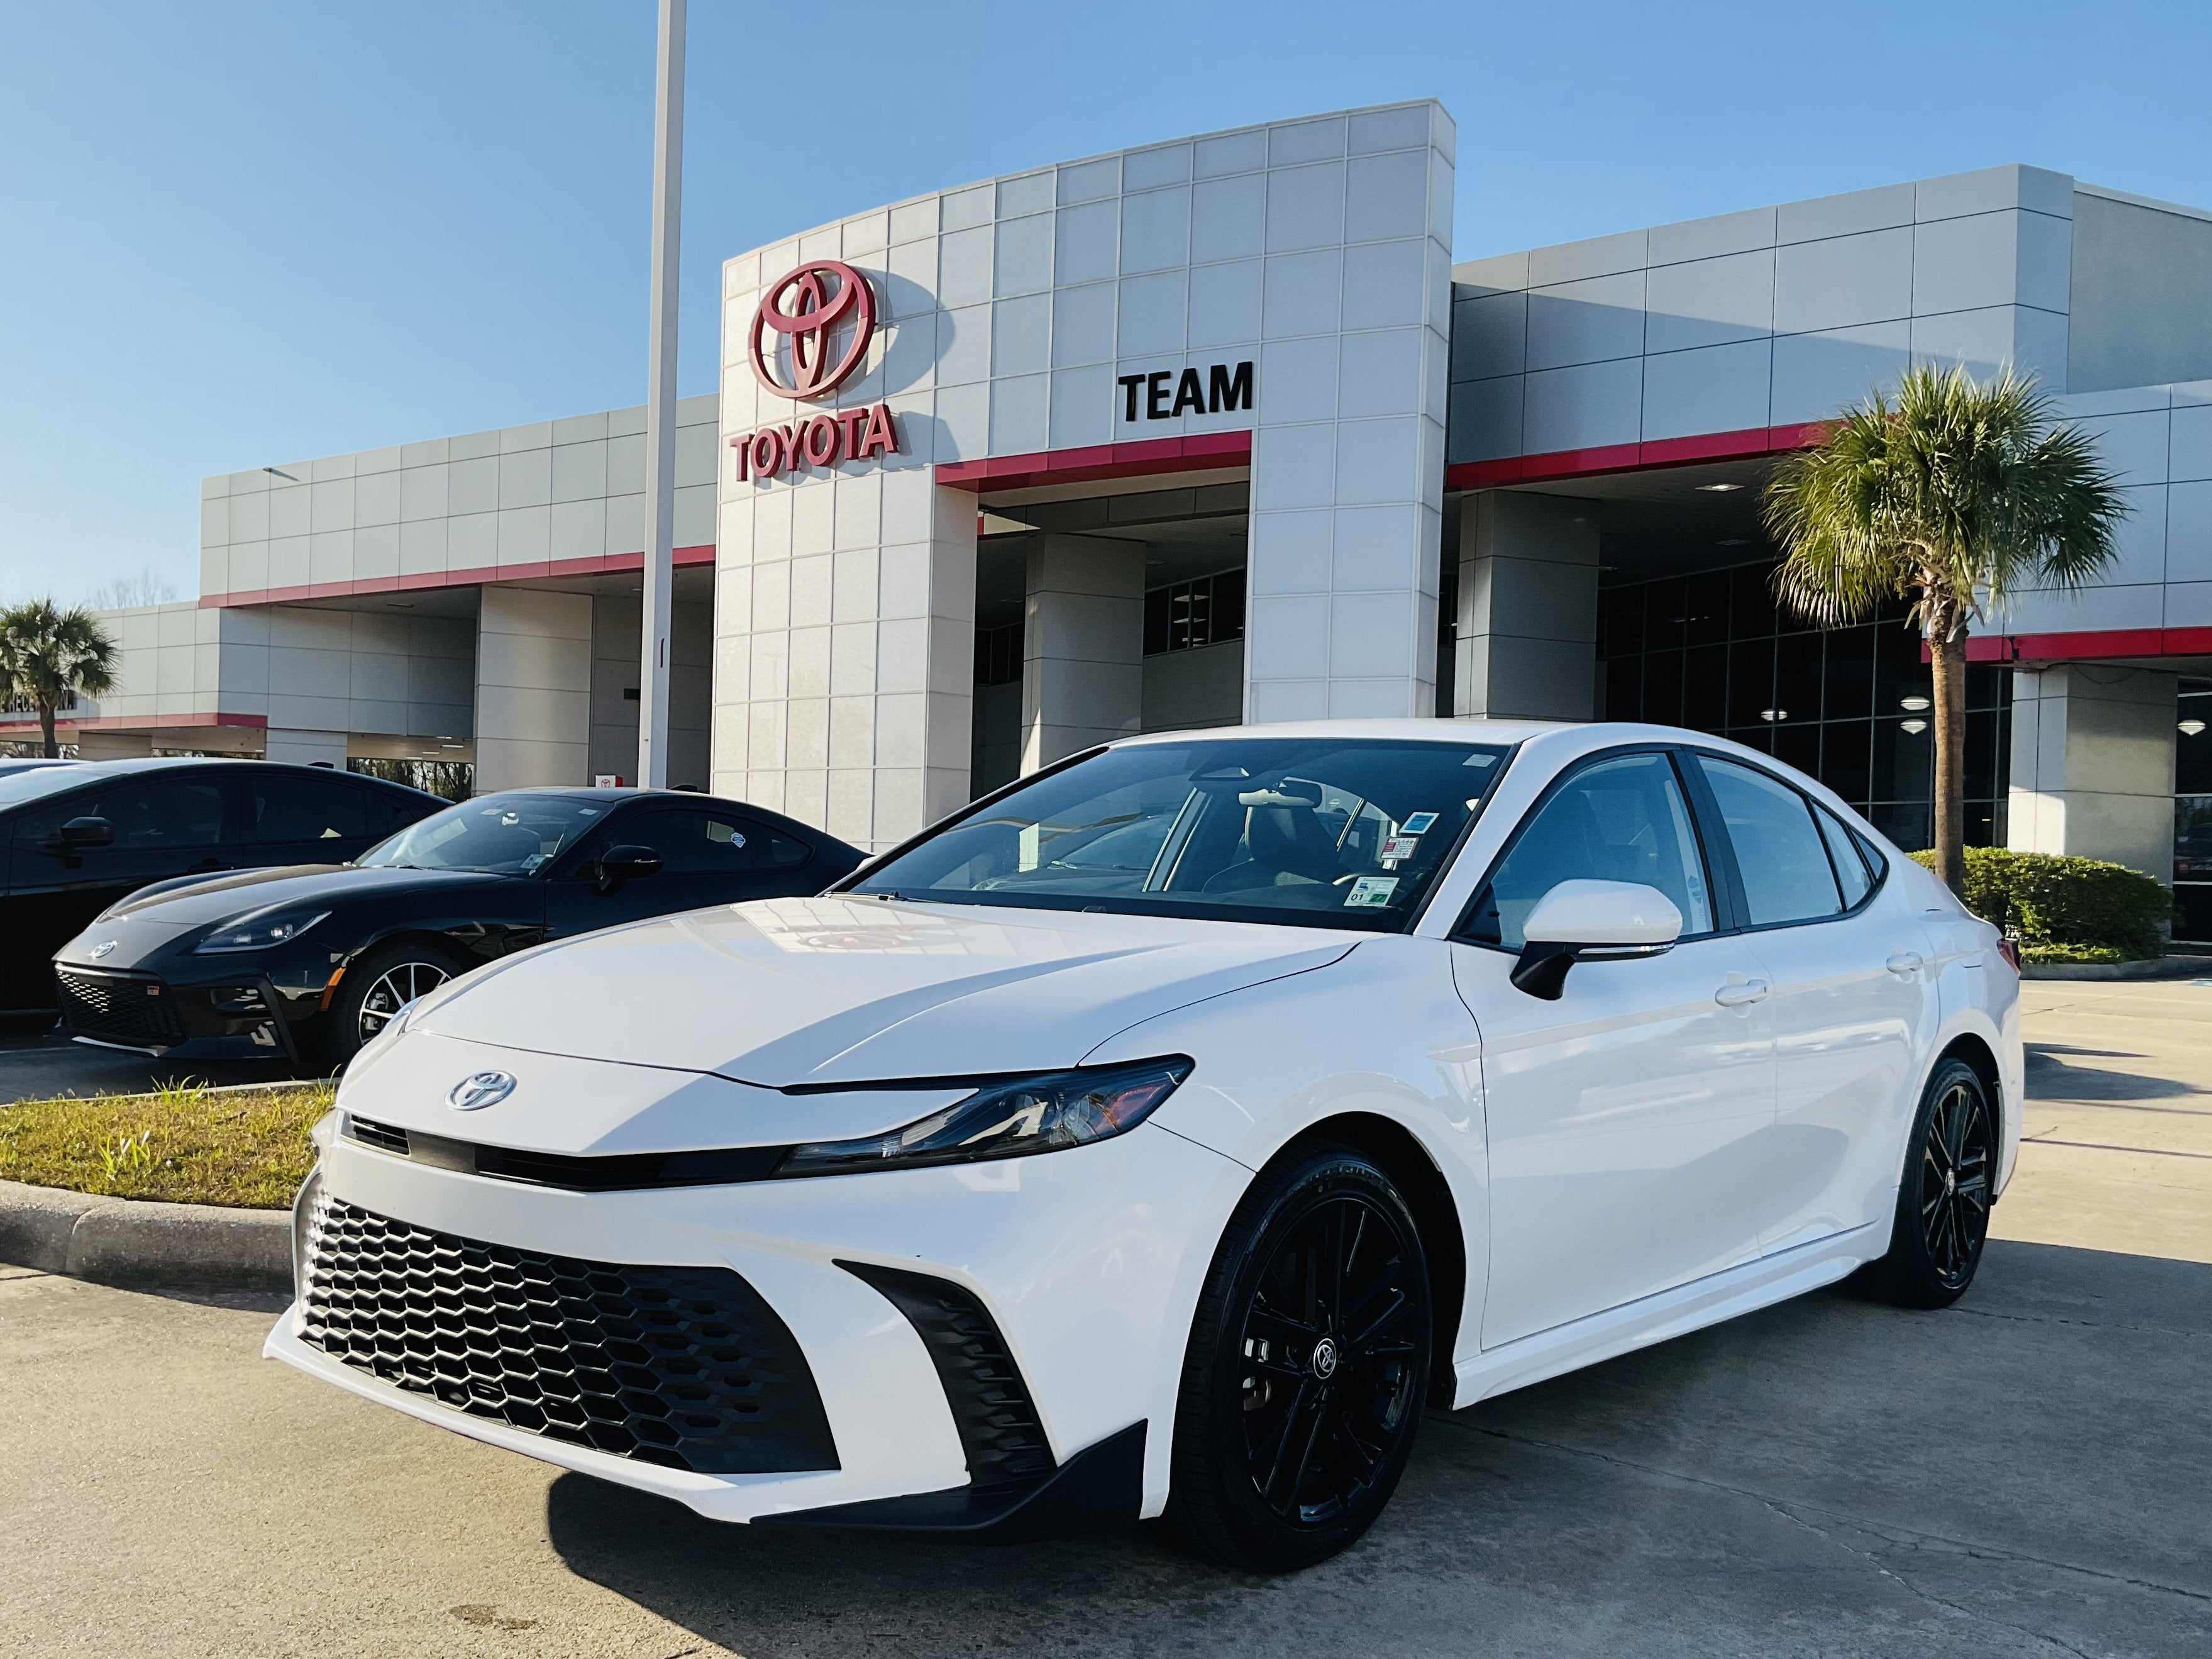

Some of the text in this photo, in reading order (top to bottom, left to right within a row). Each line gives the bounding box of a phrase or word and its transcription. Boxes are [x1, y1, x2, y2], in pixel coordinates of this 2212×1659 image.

[1118, 361, 1253, 422] TEAM
[729, 404, 900, 482] TOYOTA
[1351, 893, 1364, 901] 01
